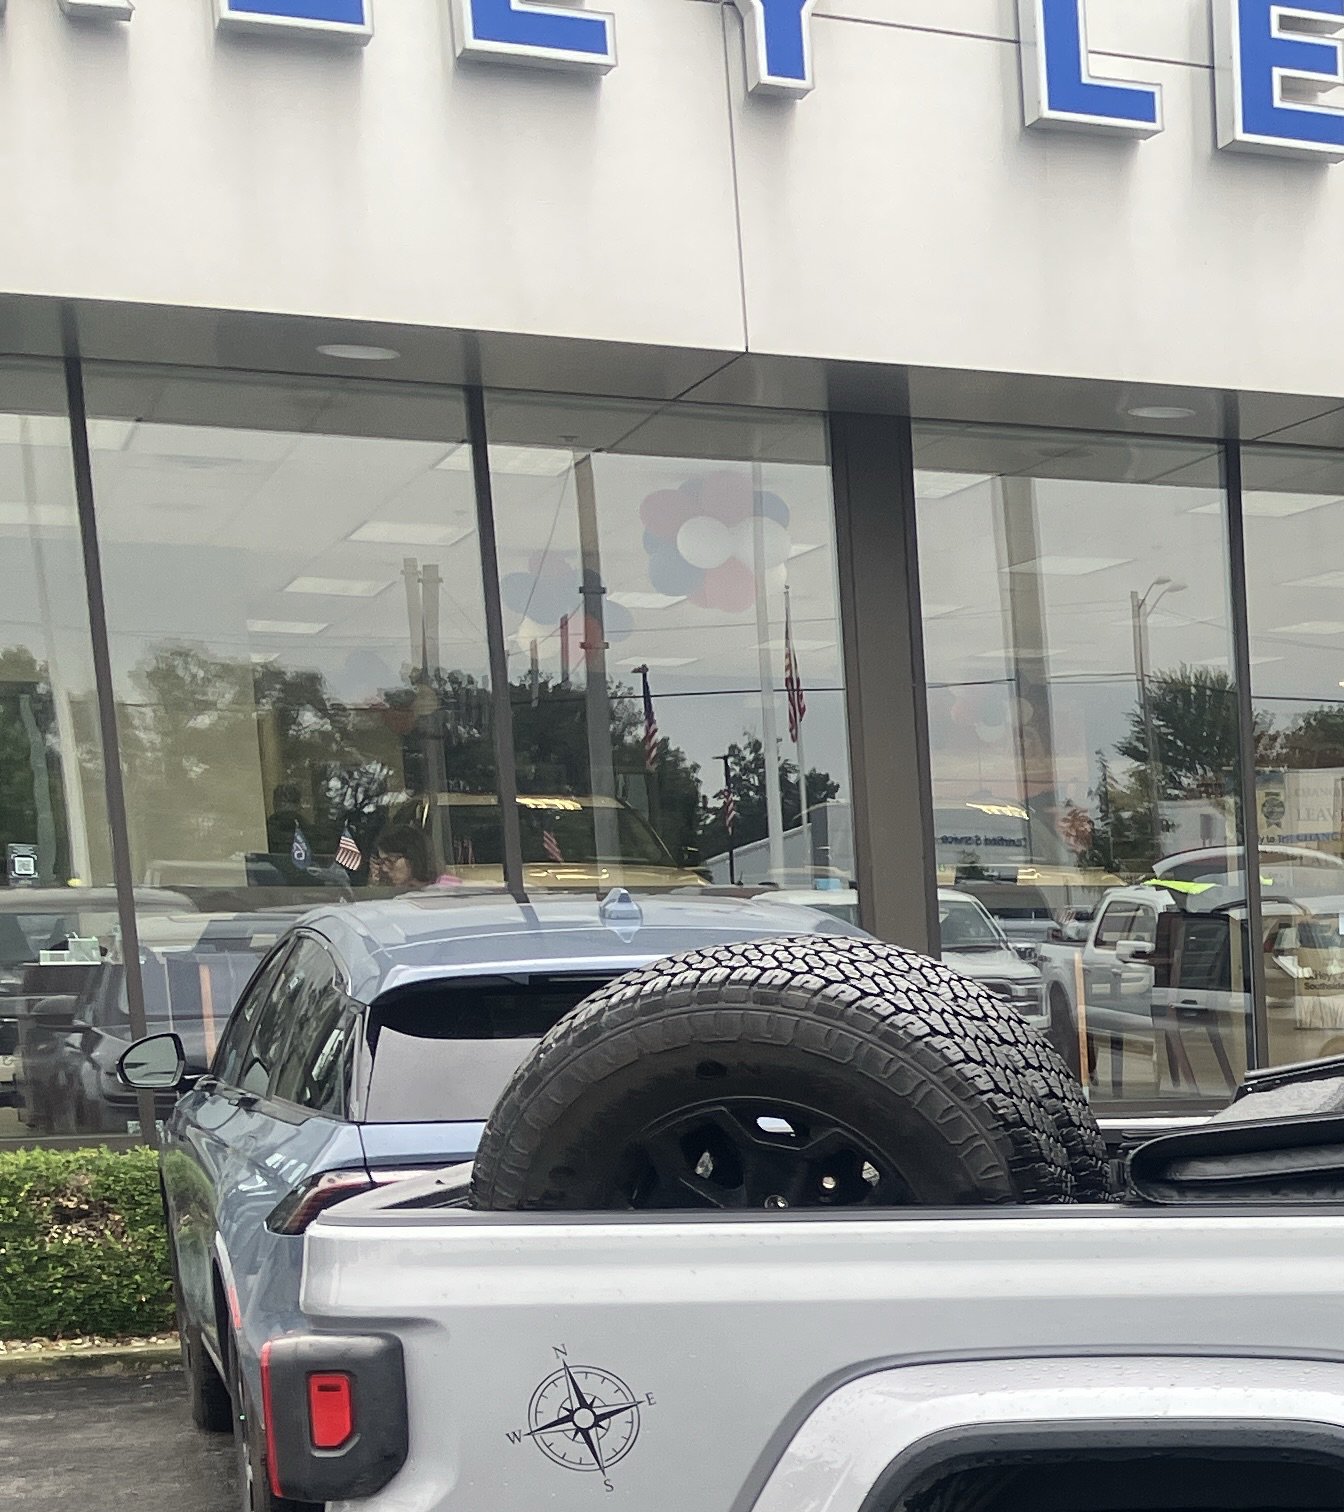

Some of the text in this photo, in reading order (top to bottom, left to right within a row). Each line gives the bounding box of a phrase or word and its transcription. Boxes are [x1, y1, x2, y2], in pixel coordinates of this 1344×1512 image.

[552, 1343, 568, 1359] N
[645, 1391, 657, 1406] E
[505, 1429, 523, 1446] W
[603, 1478, 615, 1493] S
